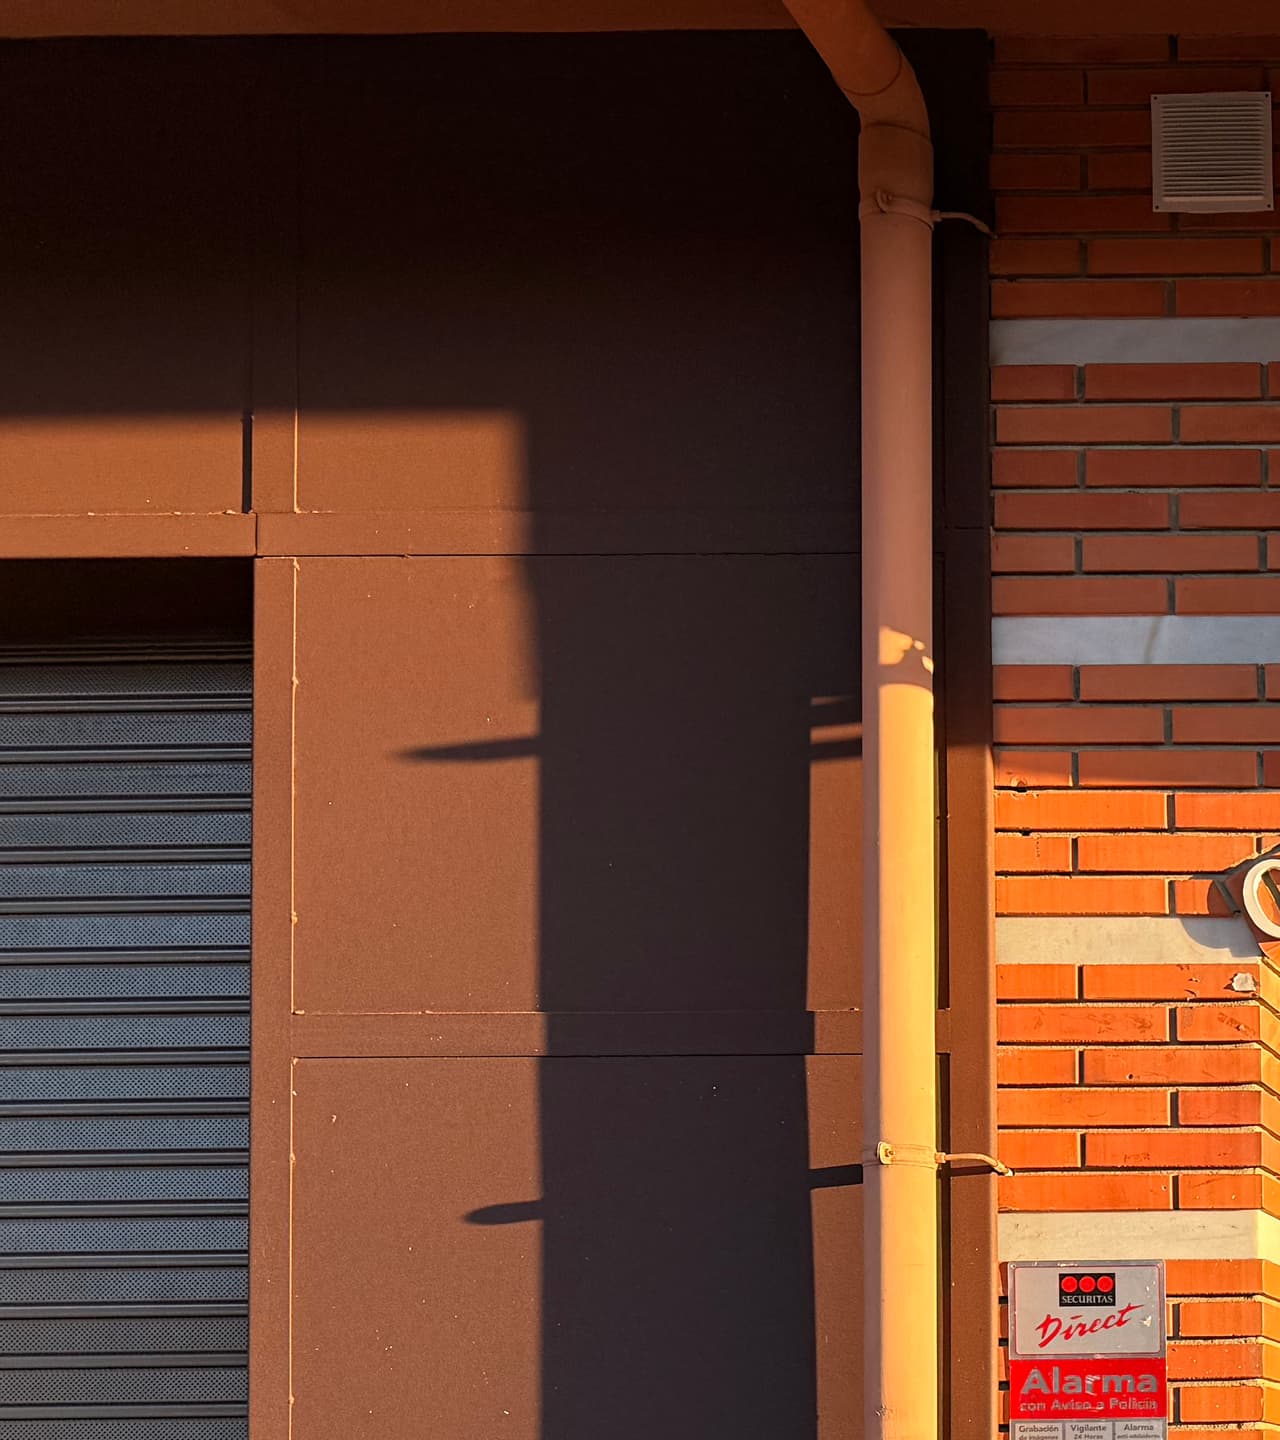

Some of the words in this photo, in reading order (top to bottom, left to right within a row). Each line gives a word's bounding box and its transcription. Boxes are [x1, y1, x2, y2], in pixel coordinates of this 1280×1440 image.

[1062, 1295, 1113, 1304] SECURITAS
[1035, 1303, 1144, 1348] Direct
[1020, 1366, 1158, 1396] Alarma
[1019, 1402, 1046, 1412] con
[1051, 1399, 1092, 1411] Aviso
[1018, 1425, 1059, 1433] Grabación
[1070, 1424, 1107, 1434] Vigilante
[1123, 1423, 1154, 1432] Alarma
